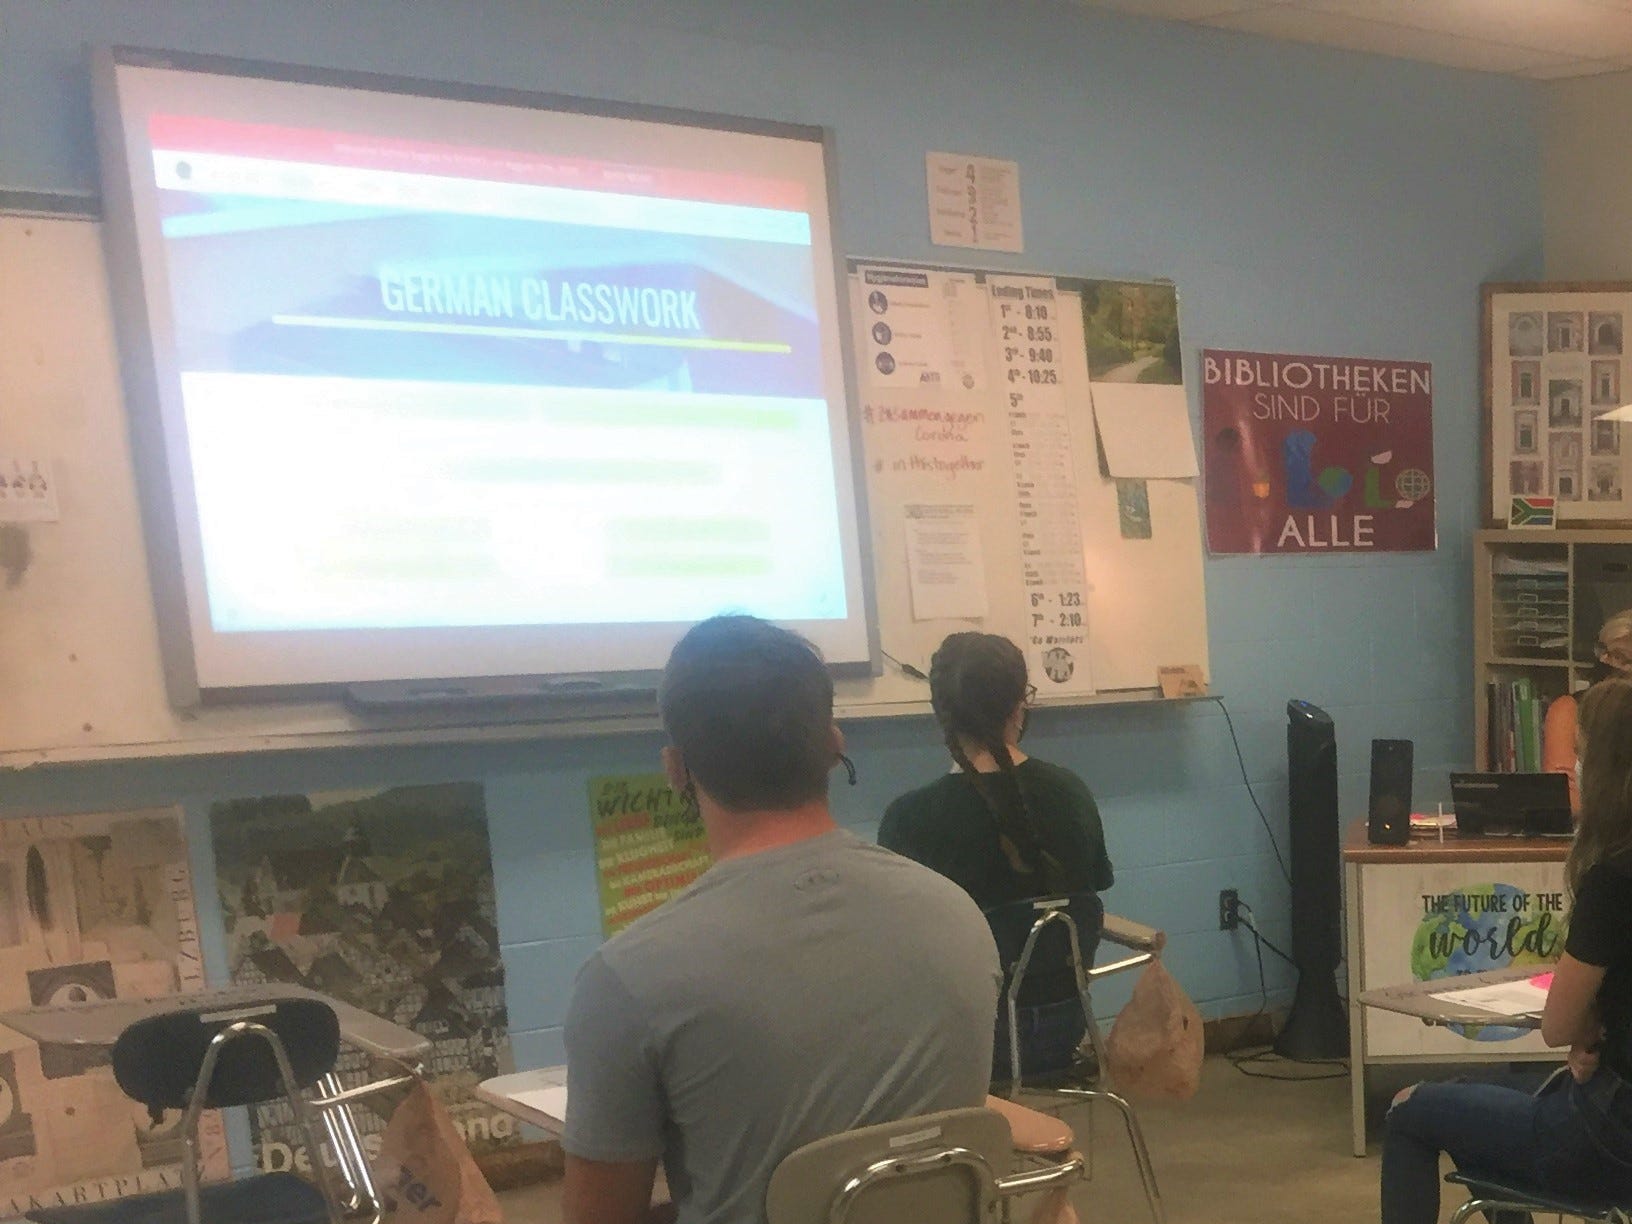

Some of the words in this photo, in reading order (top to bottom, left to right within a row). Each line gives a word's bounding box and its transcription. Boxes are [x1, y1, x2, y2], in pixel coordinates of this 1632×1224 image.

[379, 269, 513, 319] GERMAN
[520, 278, 701, 331] CLASSWORK
[1204, 356, 1431, 395] BIBLIOTHEKEN
[1253, 392, 1321, 422] SIND
[1333, 393, 1391, 424] FÜR
[1276, 514, 1375, 548] ALLE
[1421, 894, 1450, 913] THE
[1453, 893, 1508, 913] FUTURE
[1512, 893, 1532, 912] OF
[1535, 892, 1563, 912] THE
[1428, 912, 1558, 961] world
